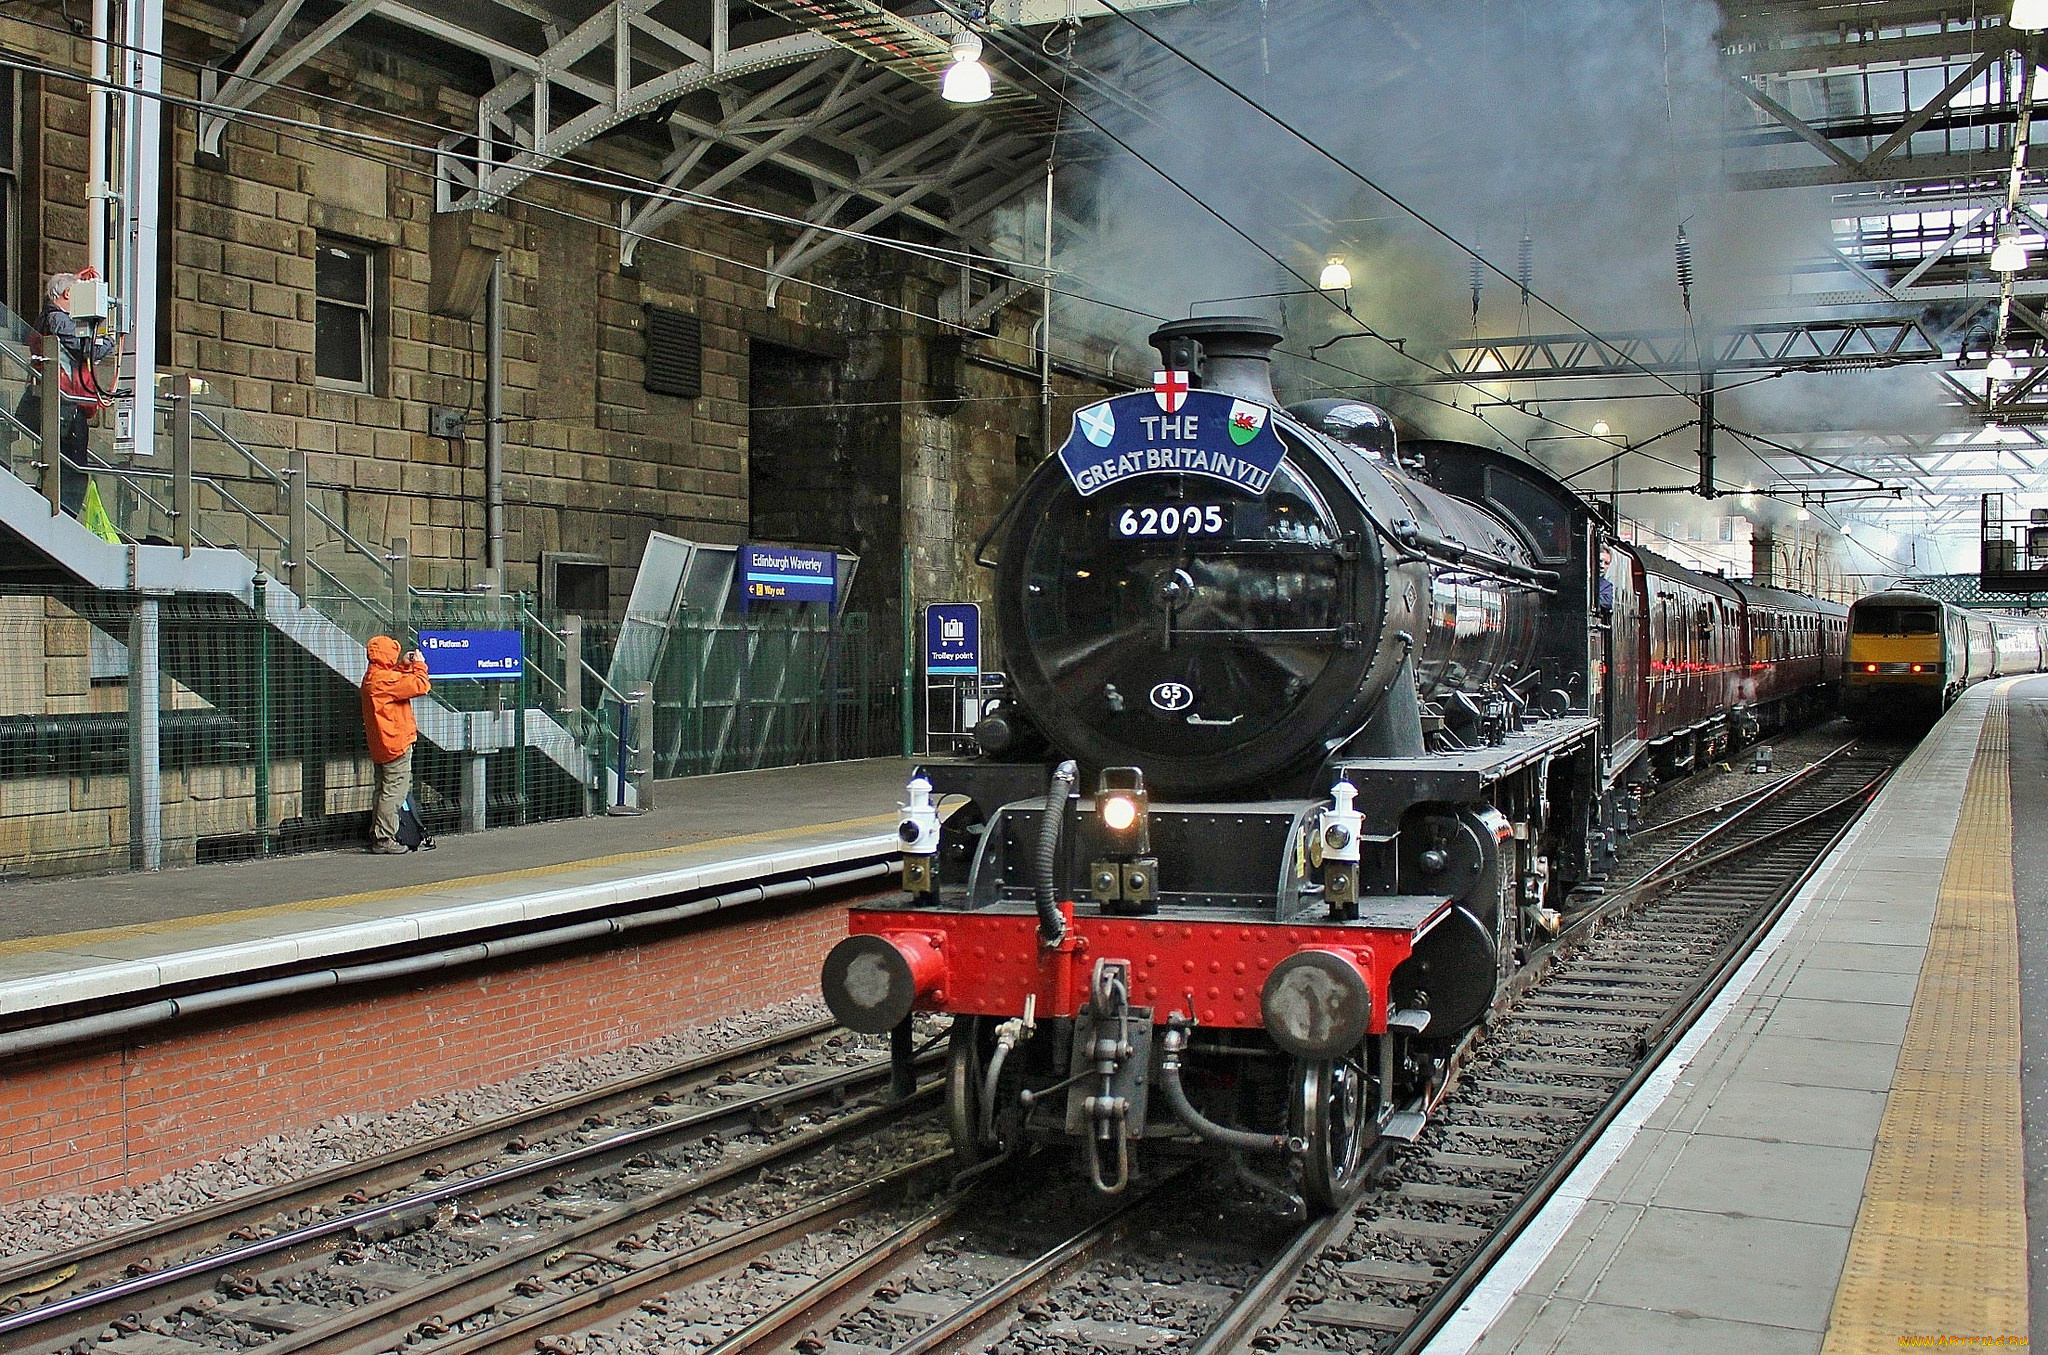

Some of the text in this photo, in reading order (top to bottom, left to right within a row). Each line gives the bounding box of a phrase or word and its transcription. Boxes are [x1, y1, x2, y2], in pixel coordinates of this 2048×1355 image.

[1140, 415, 1199, 441] THE
[1077, 447, 1270, 491] GREAT BRITAIN VII
[1119, 505, 1223, 536] 62005
[752, 553, 822, 573] Edinburgh Waverley
[764, 585, 785, 597] Way out
[438, 639, 469, 648] Platform 20
[932, 652, 974, 661] Trolley point
[477, 660, 499, 668] Platform
[1161, 686, 1181, 699] 65
[1167, 698, 1176, 708] J
